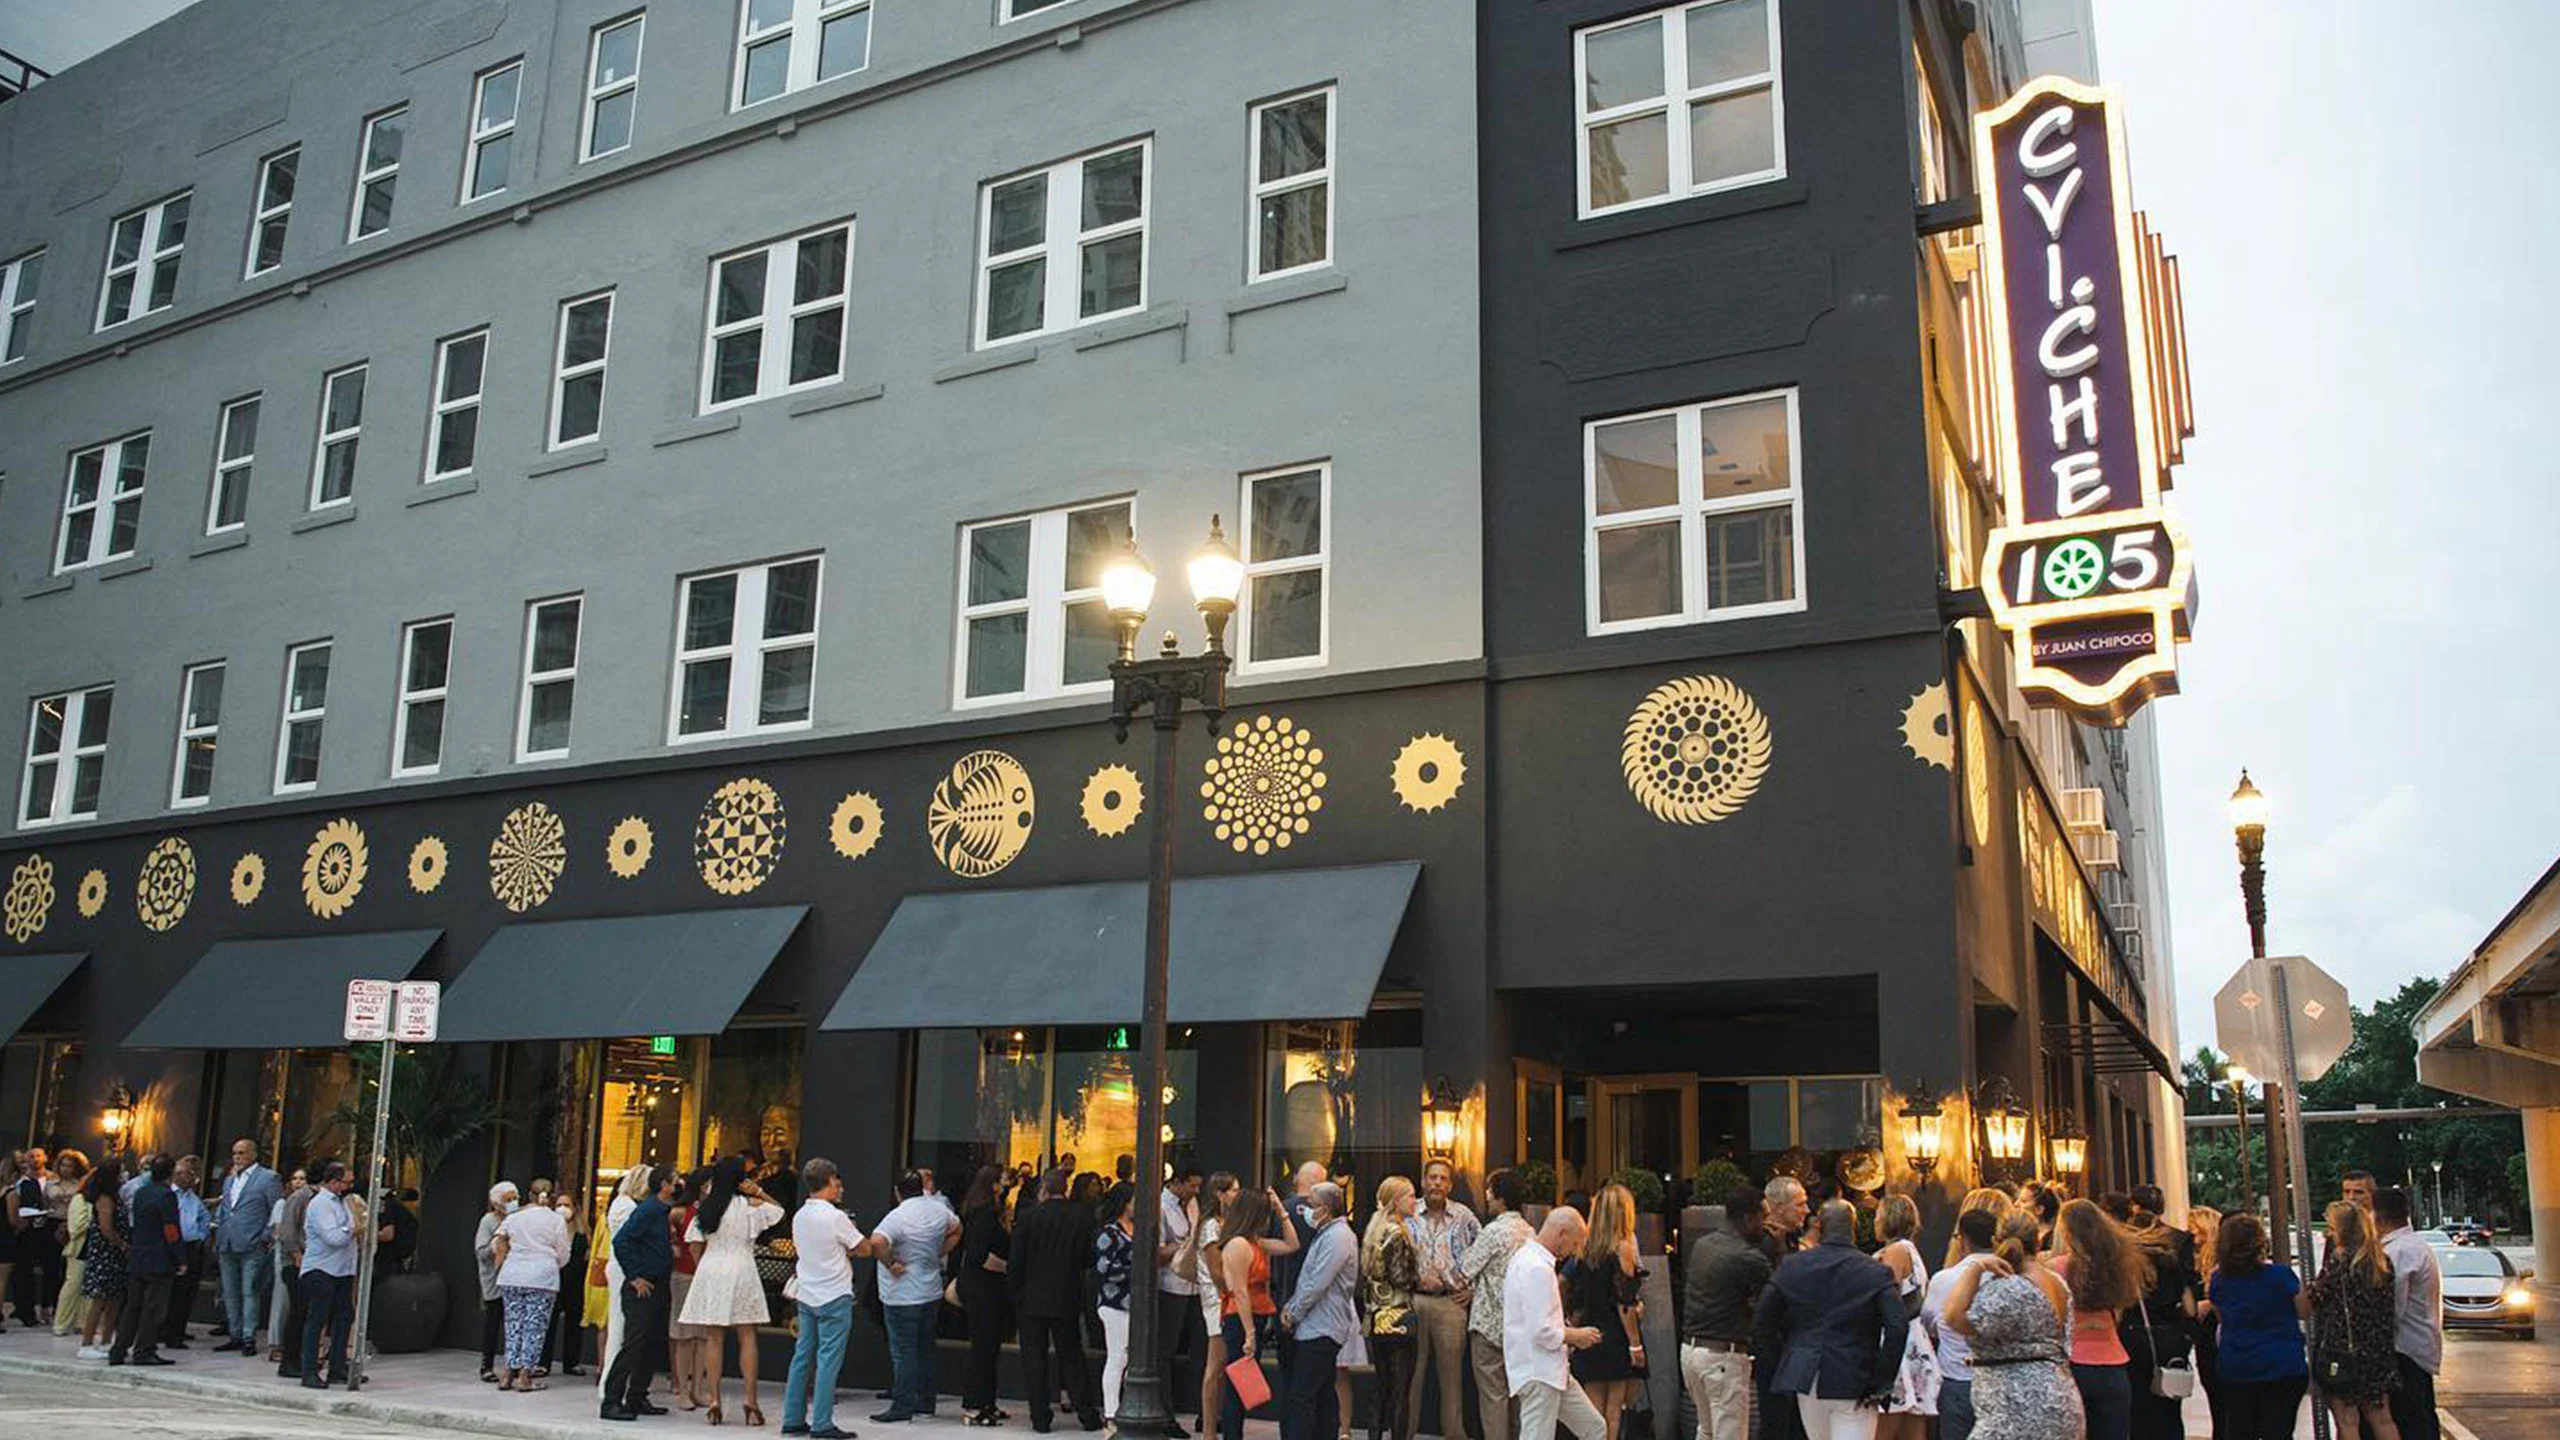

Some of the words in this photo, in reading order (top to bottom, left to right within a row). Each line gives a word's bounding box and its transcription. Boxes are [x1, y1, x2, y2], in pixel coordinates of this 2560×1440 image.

[2016, 529, 2159, 604] 105
[2033, 643, 2049, 656] BY
[2051, 640, 2086, 655] JUAN
[2089, 632, 2154, 650] CHIPOCO
[412, 986, 426, 996] NO
[353, 996, 384, 1005] VALET
[401, 995, 435, 1006] PARKING
[356, 1004, 380, 1014] ONLY
[410, 1006, 426, 1015] ANY
[408, 1015, 427, 1025] TIME
